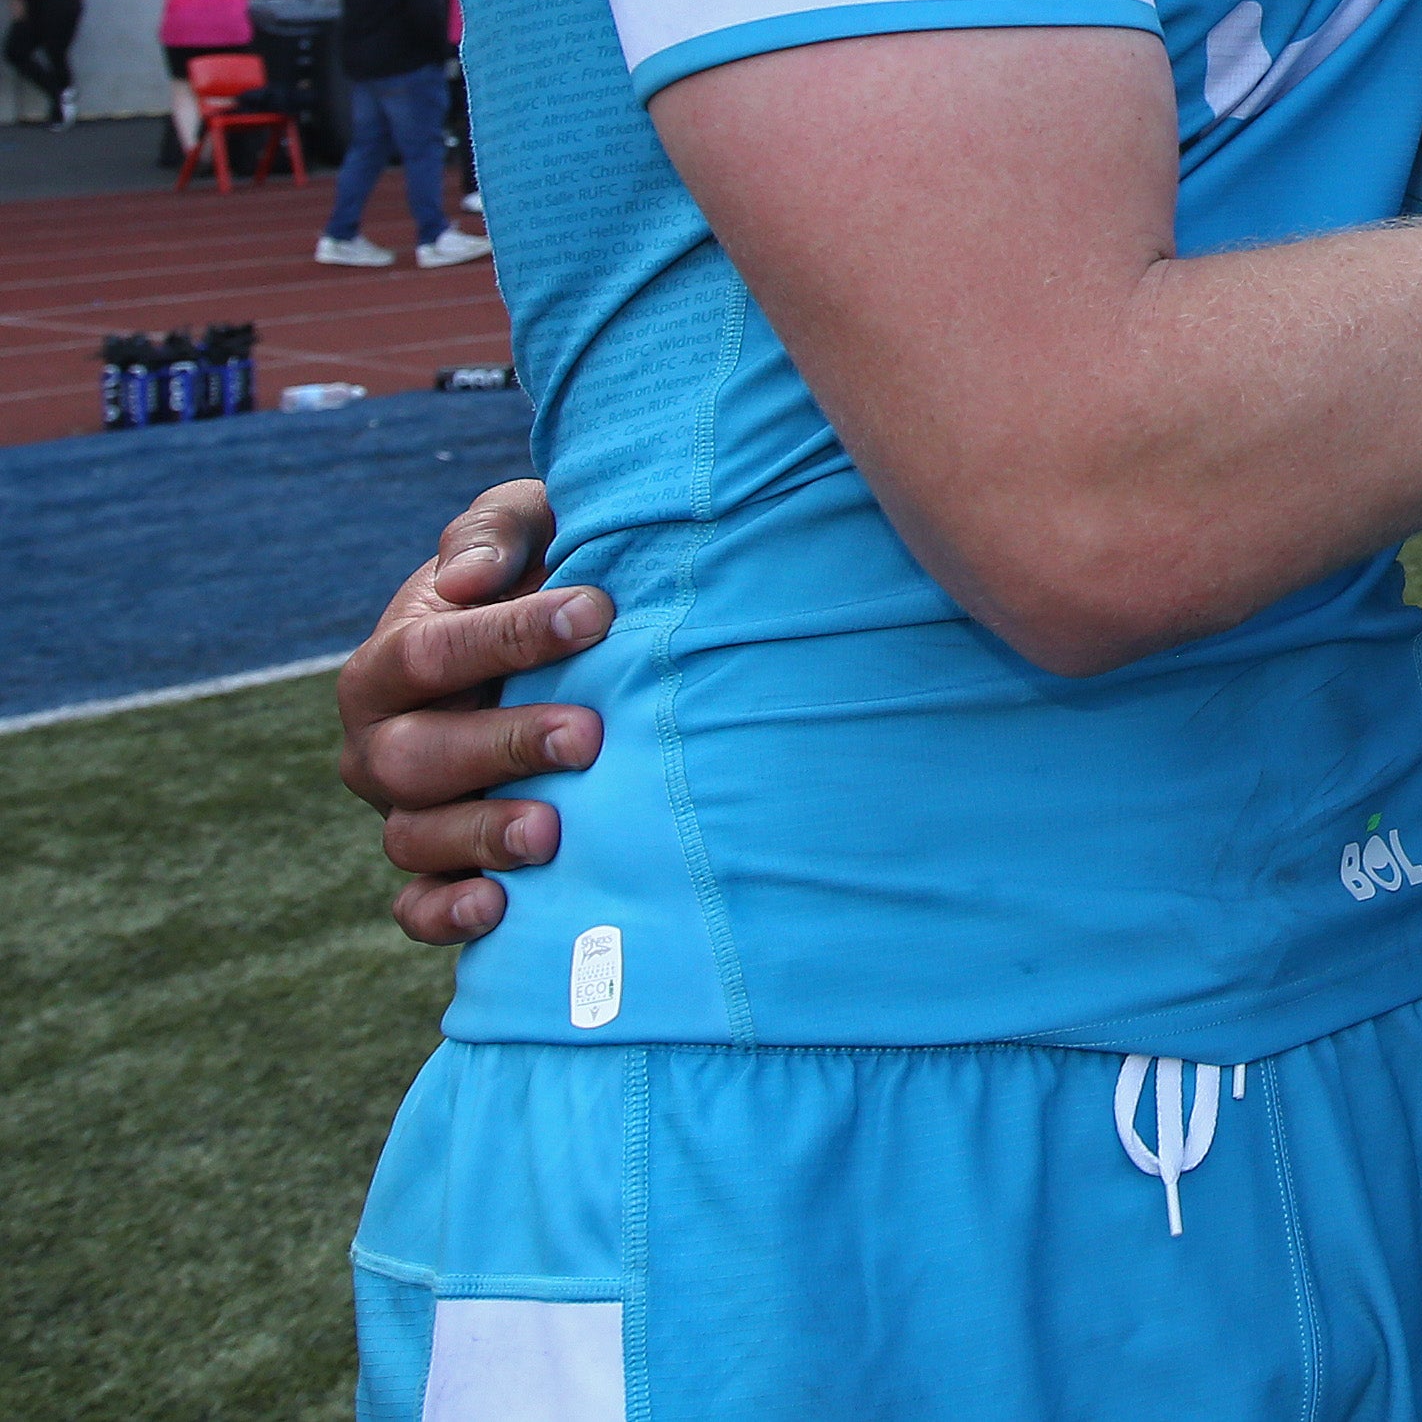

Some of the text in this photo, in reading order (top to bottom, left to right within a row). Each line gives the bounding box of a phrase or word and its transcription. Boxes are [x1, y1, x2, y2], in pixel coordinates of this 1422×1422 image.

[556, 128, 584, 146] RFC
[603, 140, 634, 157] RFC
[544, 169, 581, 187] RUFC
[578, 182, 620, 202] RUFC
[624, 196, 667, 215] RUFC
[545, 229, 581, 247] RUFC
[642, 214, 683, 232] RUFC
[611, 241, 645, 256] Club
[652, 317, 688, 335] Lune
[690, 308, 728, 326] RUFC
[625, 342, 651, 362] RFC
[640, 356, 678, 376] RUFC
[647, 393, 684, 414] RUFC
[633, 430, 669, 452] RUFC
[576, 981, 607, 999] ECO
